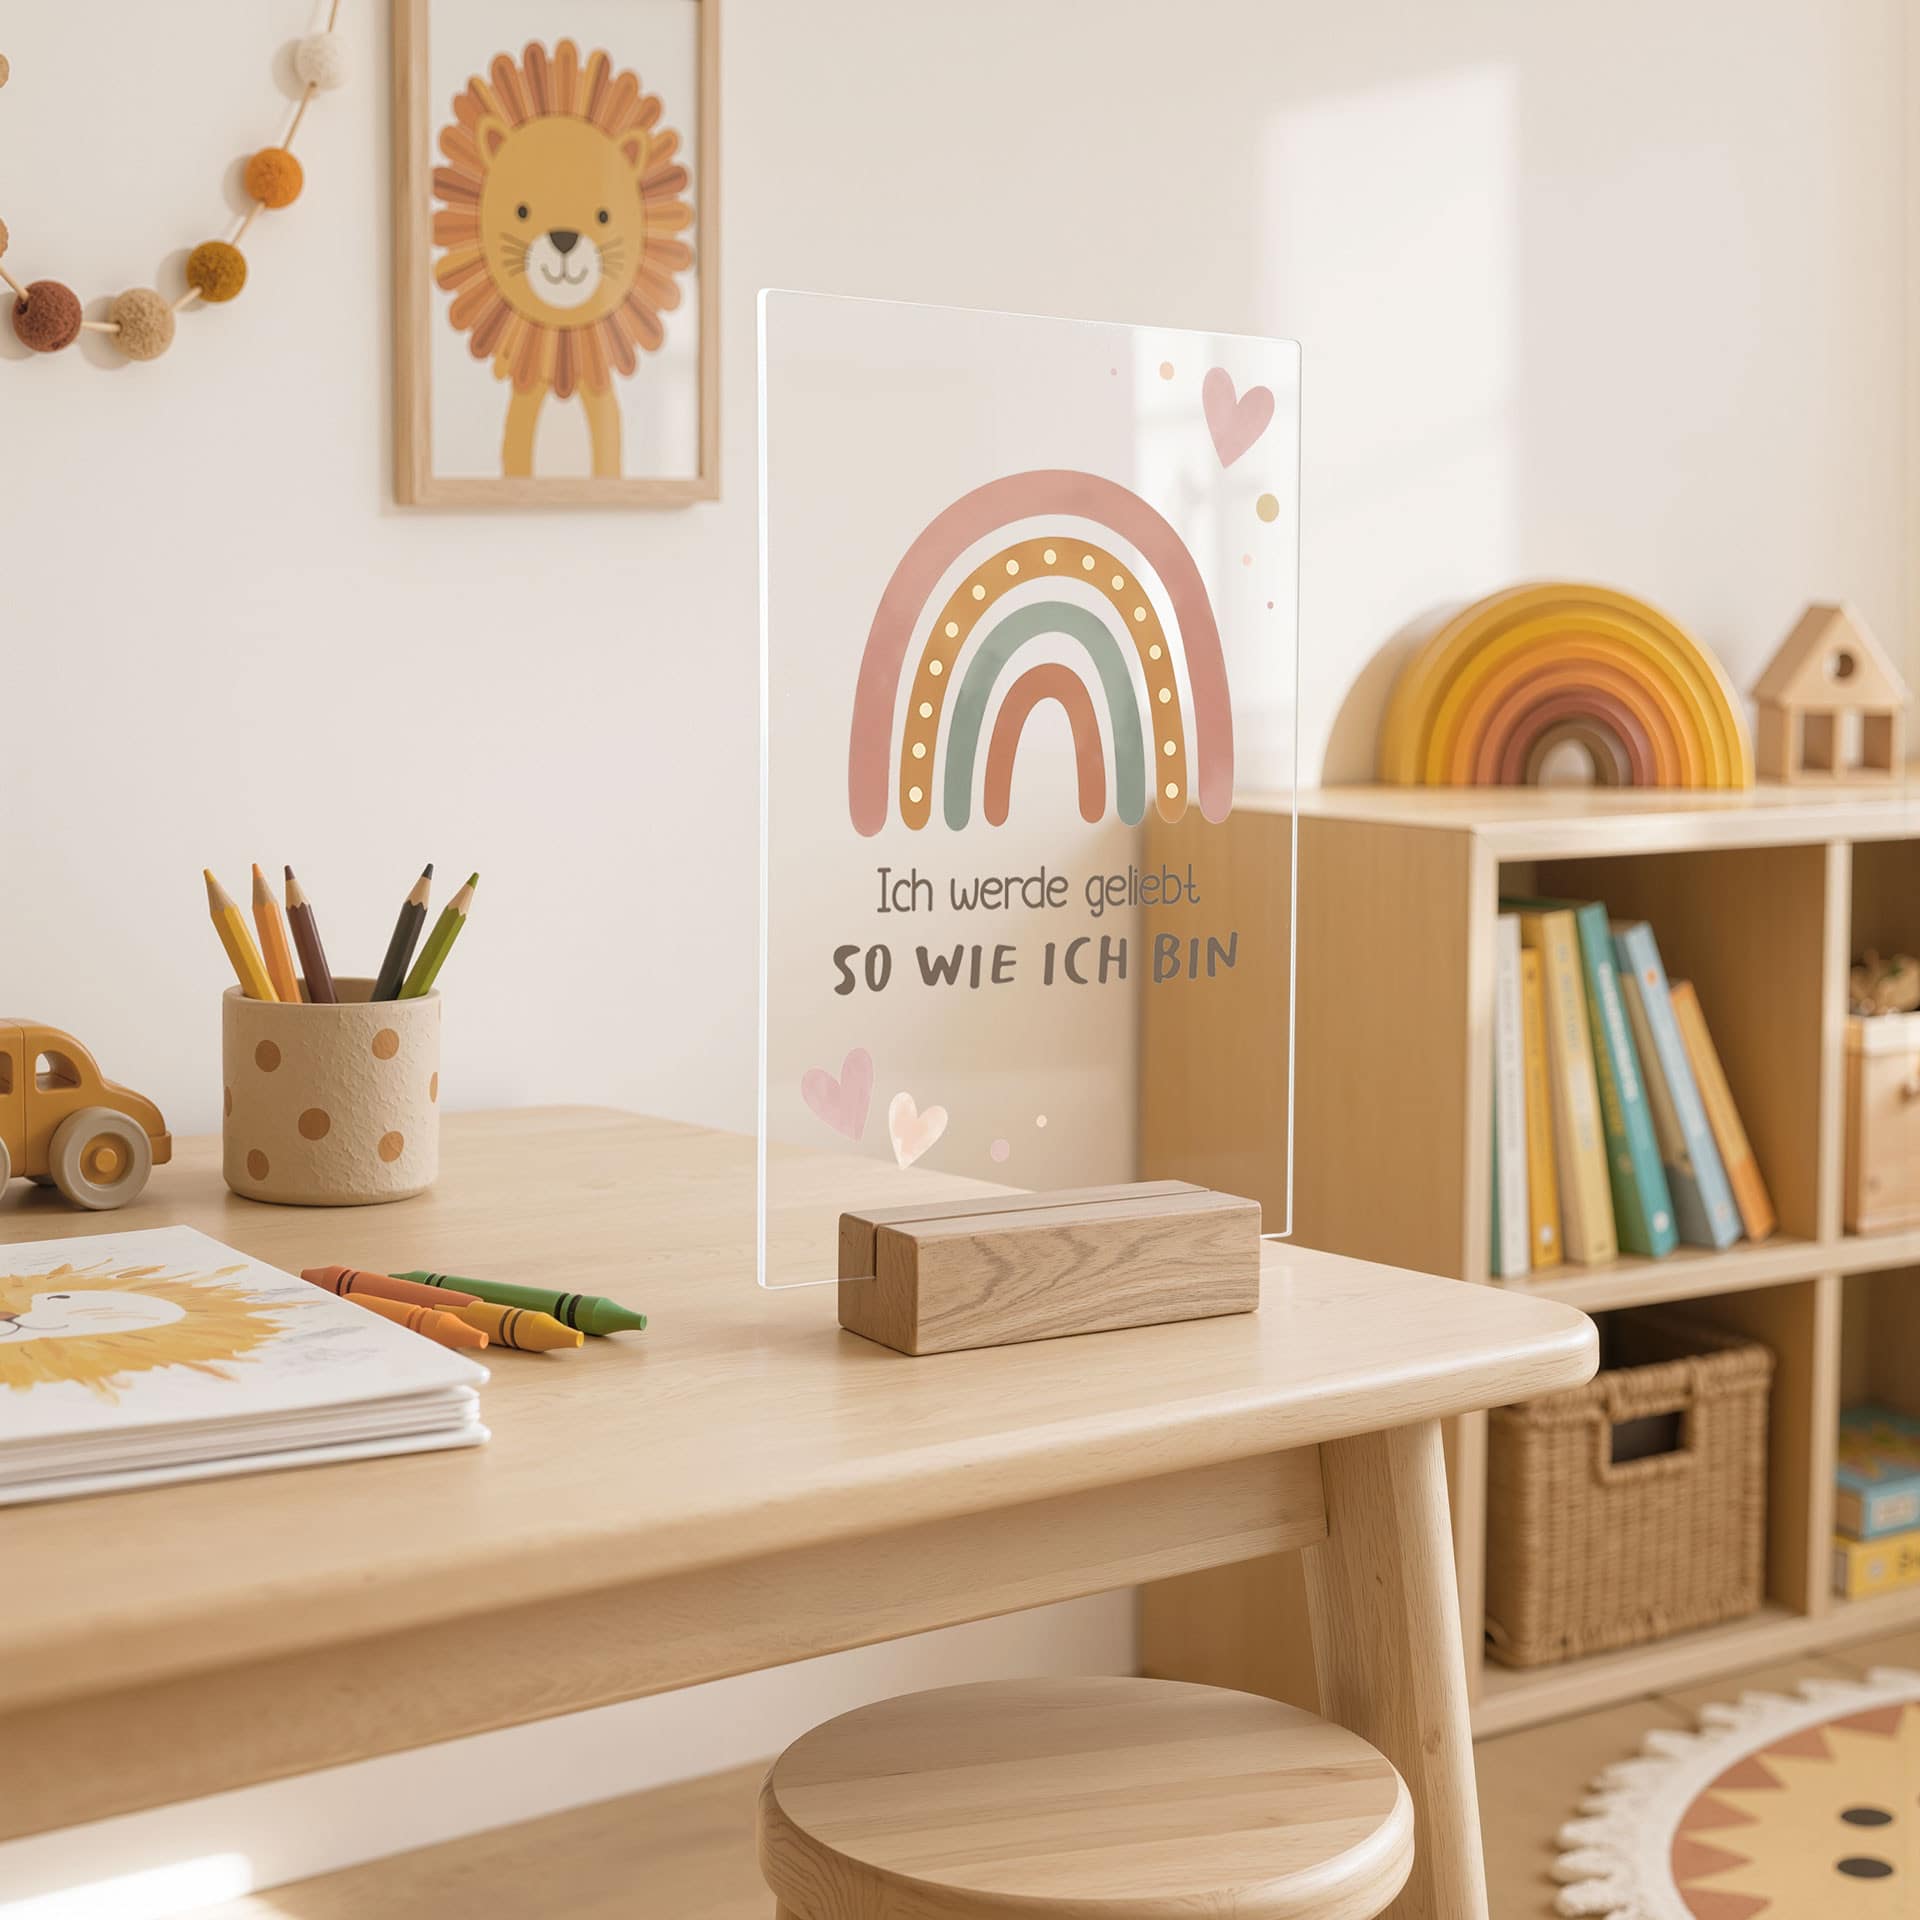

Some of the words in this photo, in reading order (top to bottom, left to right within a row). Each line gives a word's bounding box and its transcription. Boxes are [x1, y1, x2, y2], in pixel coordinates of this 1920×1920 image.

[876, 867, 933, 913] Ich
[950, 865, 1069, 911] werde
[1085, 864, 1200, 918] geliebt
[833, 943, 892, 996] SO
[915, 943, 1017, 990] WIE
[1043, 934, 1128, 986] ICH
[1153, 931, 1239, 984] BIN
